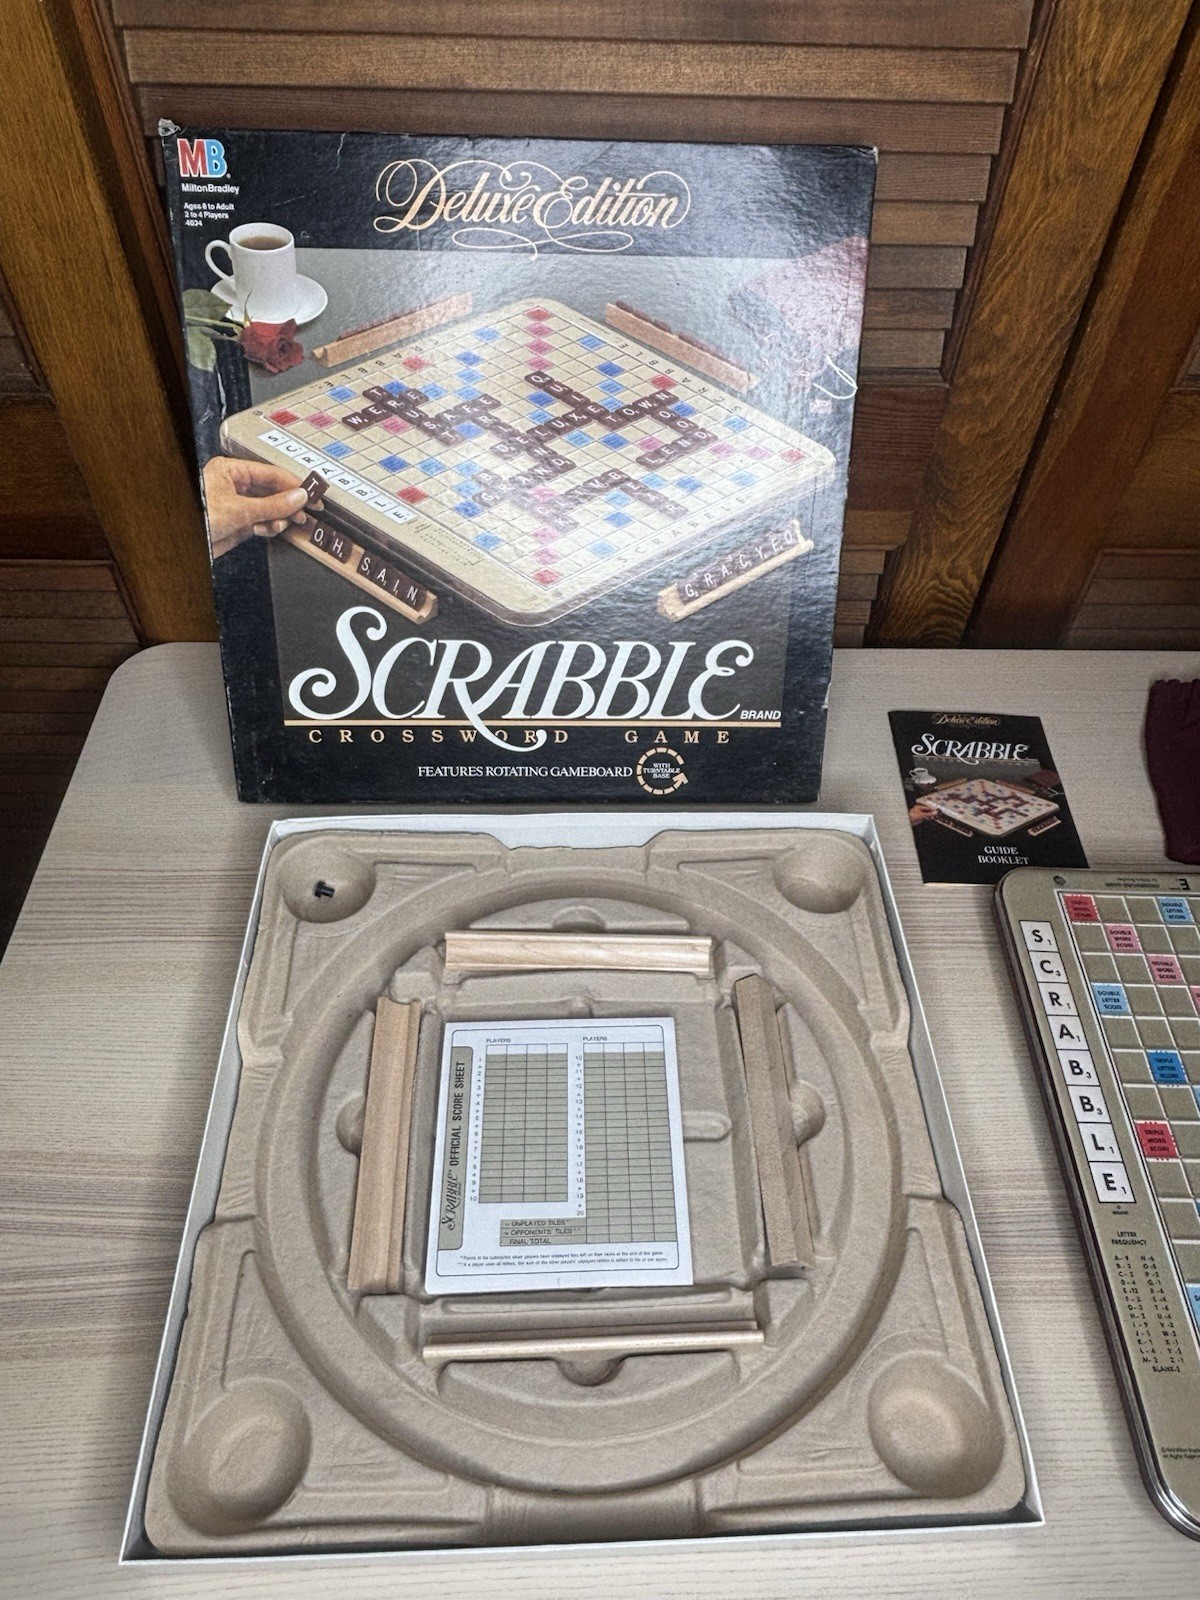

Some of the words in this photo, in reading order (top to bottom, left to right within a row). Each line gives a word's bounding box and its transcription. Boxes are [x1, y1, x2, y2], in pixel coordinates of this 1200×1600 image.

[374, 159, 532, 233] Deluxe
[530, 170, 690, 232] Edition
[184, 202, 201, 210] Ages
[204, 212, 230, 220] Players
[289, 606, 754, 751] SCRABBLE
[740, 711, 782, 720] BRAND
[310, 731, 568, 744] CROSSWORD
[624, 731, 731, 744] GAME
[911, 733, 1029, 766] SCRABBLE
[418, 766, 484, 778] FEATURES
[485, 766, 549, 778] ROTATING
[550, 766, 633, 778] GAMEBOARD
[984, 846, 1019, 855] GUIDE
[978, 855, 1029, 866] BOOKLET
[456, 1062, 466, 1088] SHEET
[452, 1092, 464, 1122] SCORE
[450, 1126, 462, 1167] OFFICIAL
